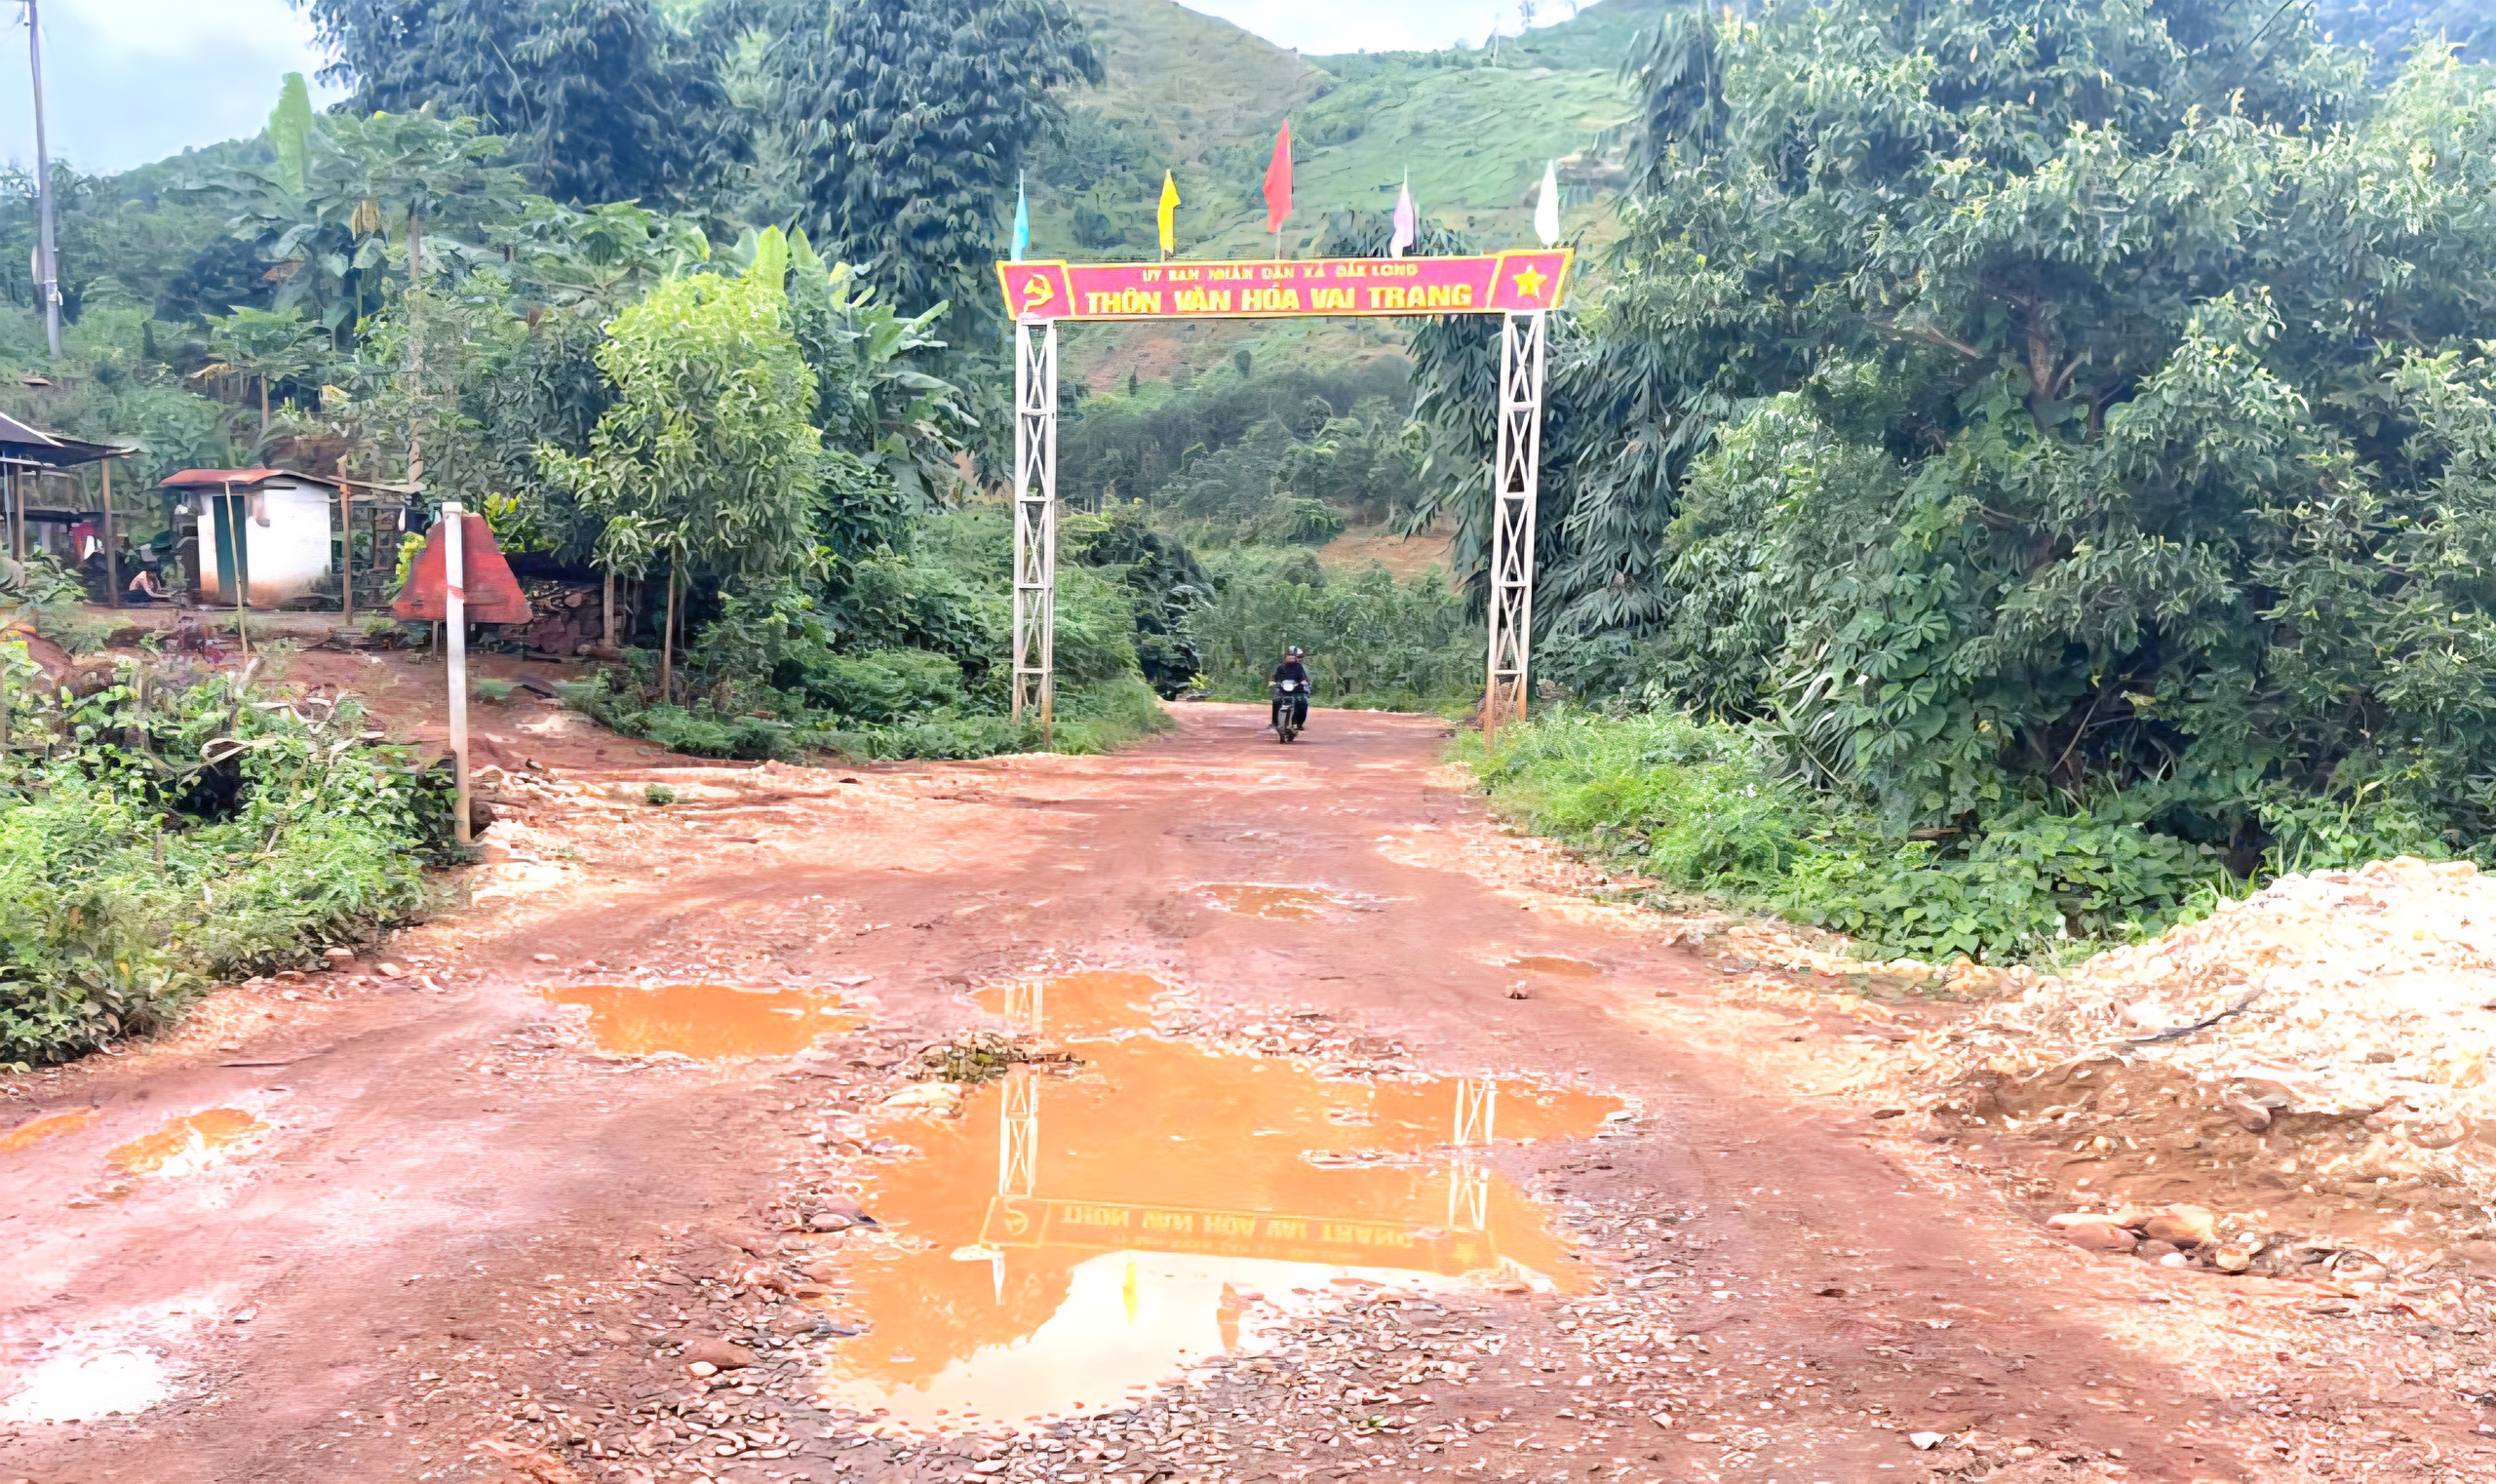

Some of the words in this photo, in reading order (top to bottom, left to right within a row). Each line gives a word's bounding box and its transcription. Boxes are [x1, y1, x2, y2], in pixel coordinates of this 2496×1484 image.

[1085, 287, 1161, 313] THÔN
[1174, 286, 1230, 311] VĂN
[1241, 283, 1300, 311] HÓA
[1310, 287, 1355, 309] VAI
[1367, 284, 1472, 309] TRANG
